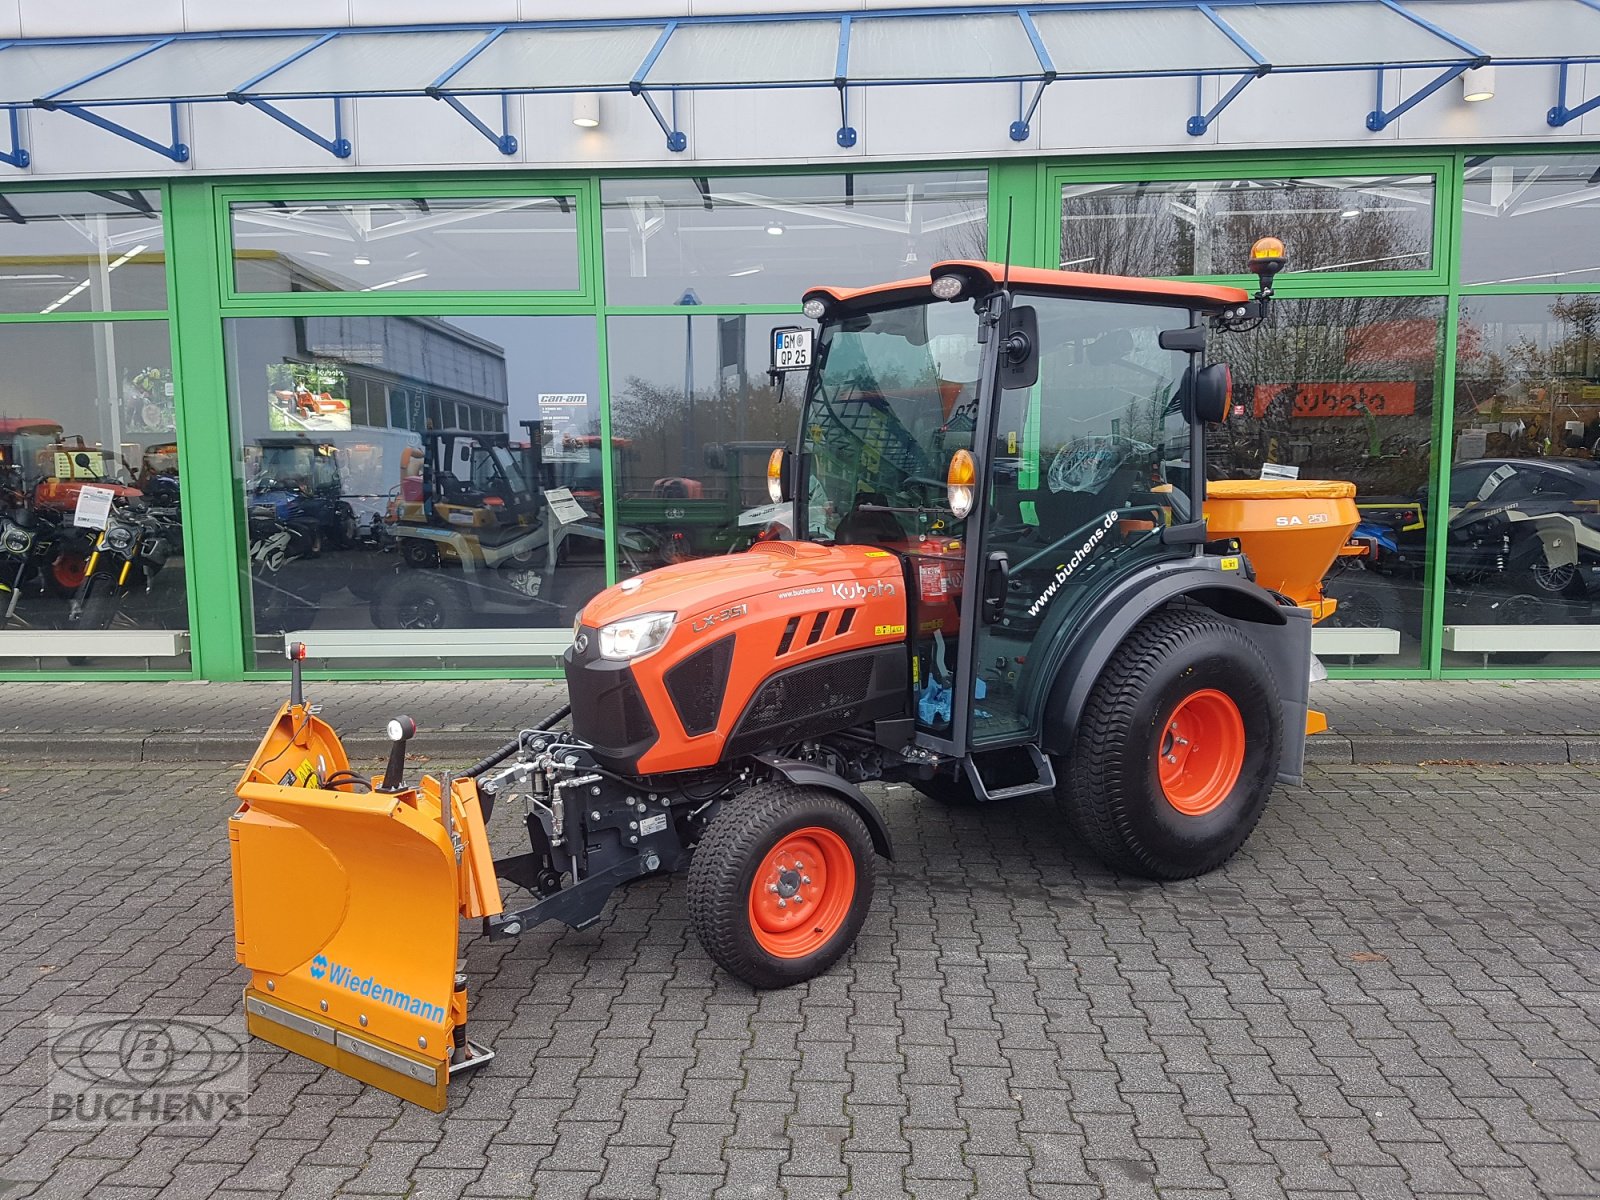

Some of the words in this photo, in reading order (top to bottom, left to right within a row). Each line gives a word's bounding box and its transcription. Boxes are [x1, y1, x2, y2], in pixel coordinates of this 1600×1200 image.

[784, 334, 796, 349] GM
[781, 350, 793, 365] QP
[795, 349, 806, 364] 25
[540, 395, 585, 403] can-am
[1275, 516, 1303, 526] SA
[1307, 513, 1329, 524] 250
[1027, 510, 1119, 617] www.buchens.de
[777, 586, 824, 599] www.buchens.de
[831, 579, 896, 600] Kubota
[691, 603, 748, 633] LX-351
[328, 962, 446, 1024] Wiedenmann
